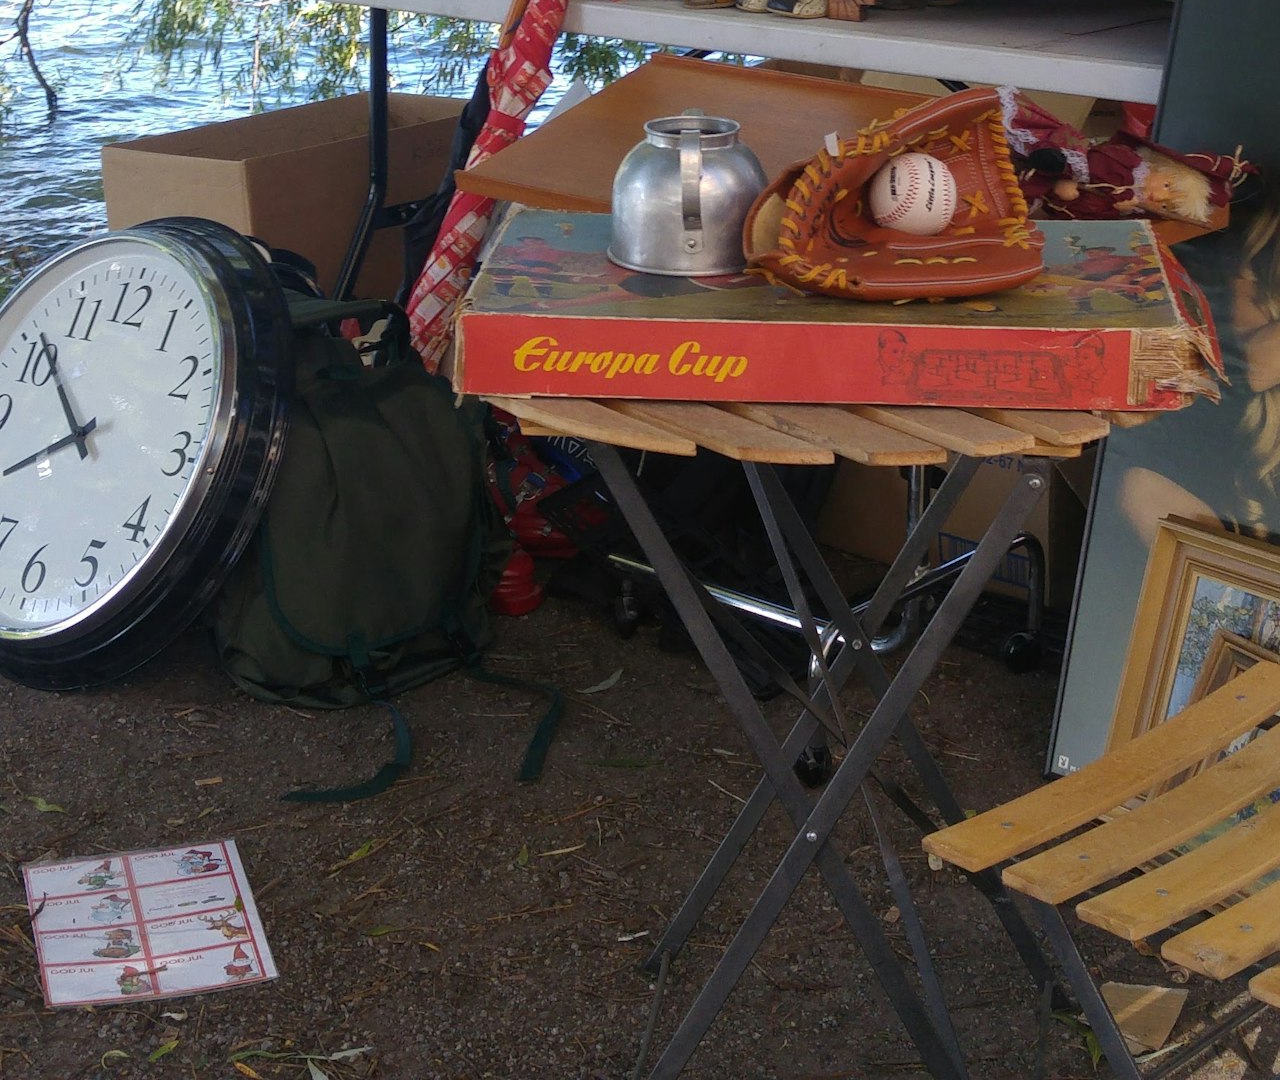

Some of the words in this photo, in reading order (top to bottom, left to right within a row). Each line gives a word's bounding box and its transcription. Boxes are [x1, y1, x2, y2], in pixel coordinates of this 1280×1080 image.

[64, 296, 103, 342] 11
[107, 281, 154, 329] 12
[154, 309, 178, 352] 1
[17, 339, 58, 388] 10
[168, 355, 199, 400] 2
[513, 336, 661, 379] Europa
[668, 340, 749, 383] Cup
[160, 430, 193, 477] 3
[122, 495, 152, 542] 4
[20, 543, 49, 594] 6
[74, 539, 107, 588] 5
